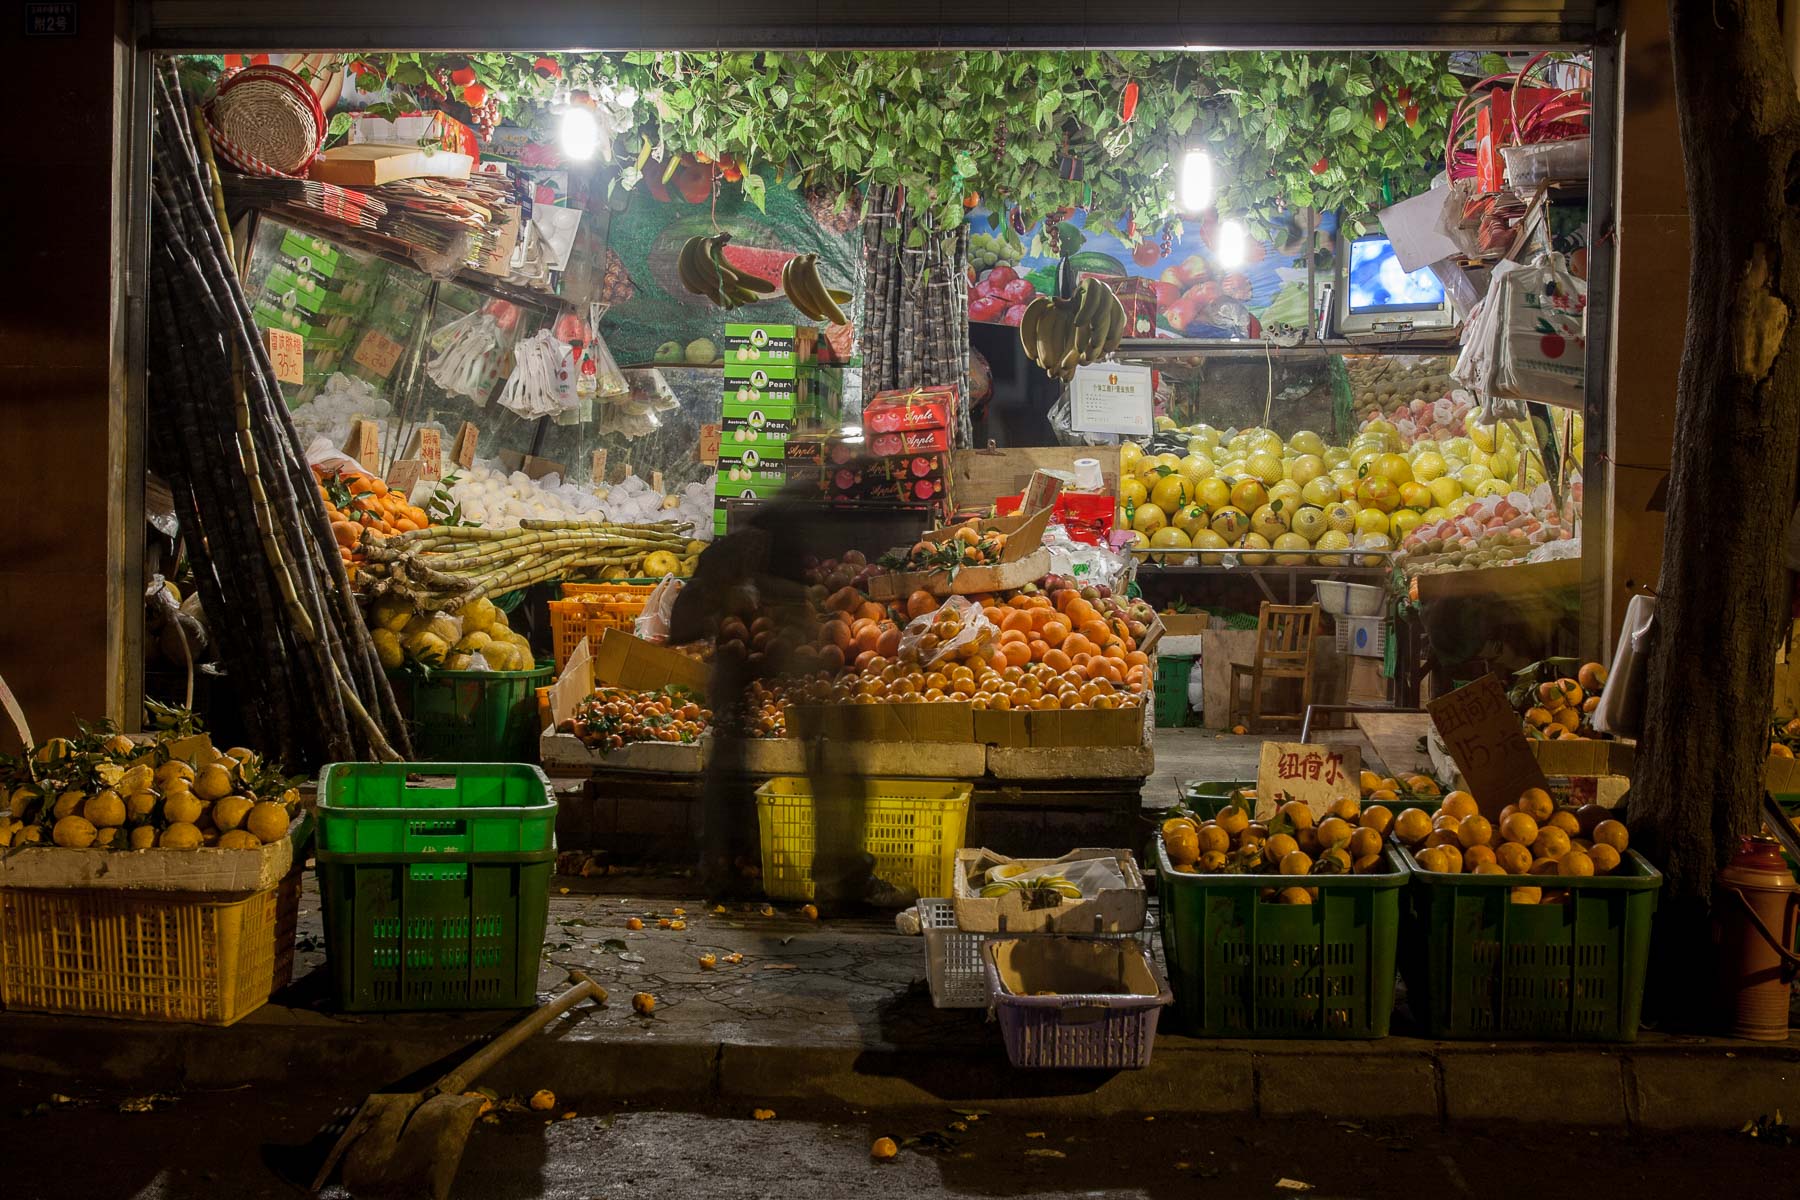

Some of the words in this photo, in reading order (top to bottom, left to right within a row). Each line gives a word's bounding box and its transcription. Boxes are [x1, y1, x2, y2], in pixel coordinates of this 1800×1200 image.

[768, 339, 787, 347] Pear
[903, 408, 933, 423] Apple
[766, 421, 785, 429] Pear
[907, 432, 935, 447] Apple
[788, 445, 816, 458] Apple
[1278, 751, 1344, 785] 纽荷尔
